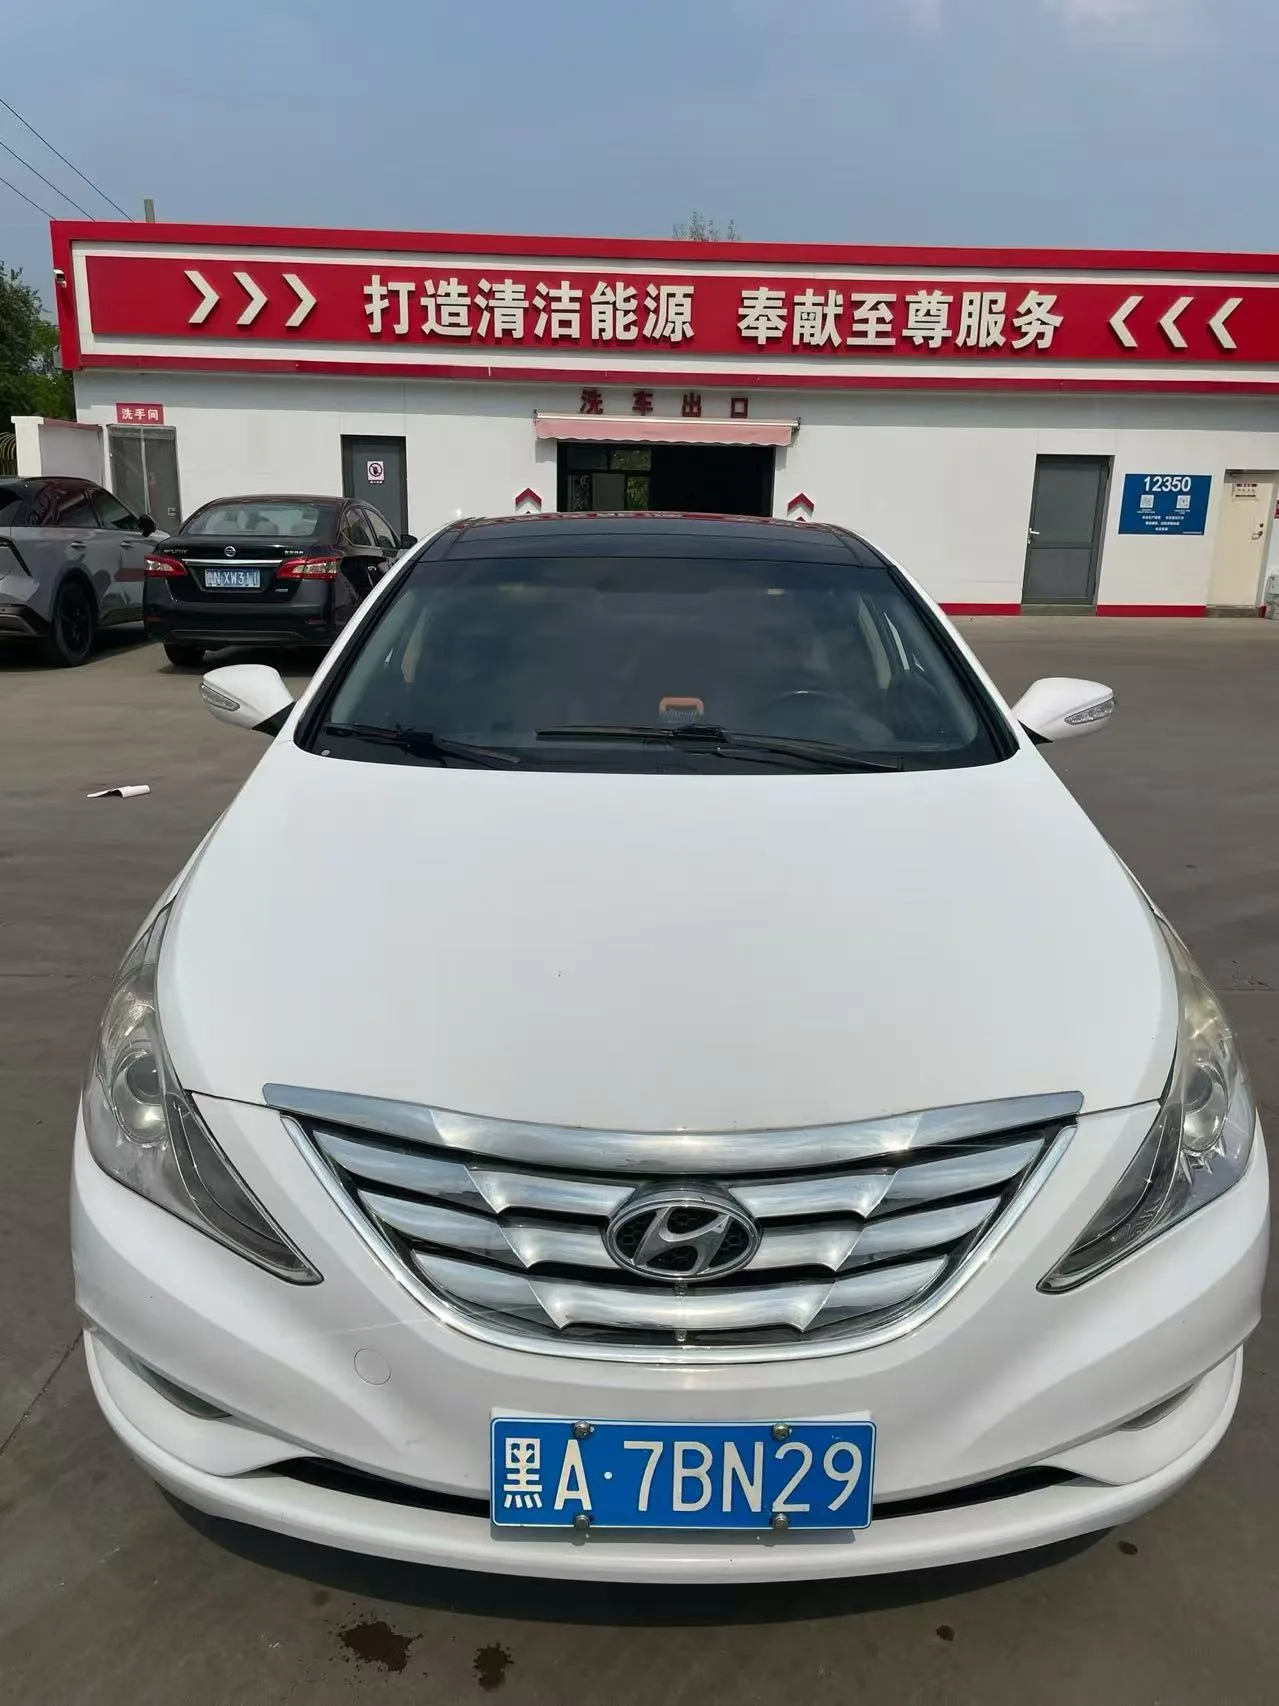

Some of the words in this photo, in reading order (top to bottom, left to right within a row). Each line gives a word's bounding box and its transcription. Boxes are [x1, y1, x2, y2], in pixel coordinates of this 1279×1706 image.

[363, 275, 695, 342] 打造清洁能源
[737, 287, 1064, 349] 奉献至尊服务
[121, 408, 159, 421] 洗手间
[580, 386, 749, 418] 洗车出口
[1144, 476, 1192, 492] 12350
[503, 1437, 864, 1513] 黑A·7BN29
